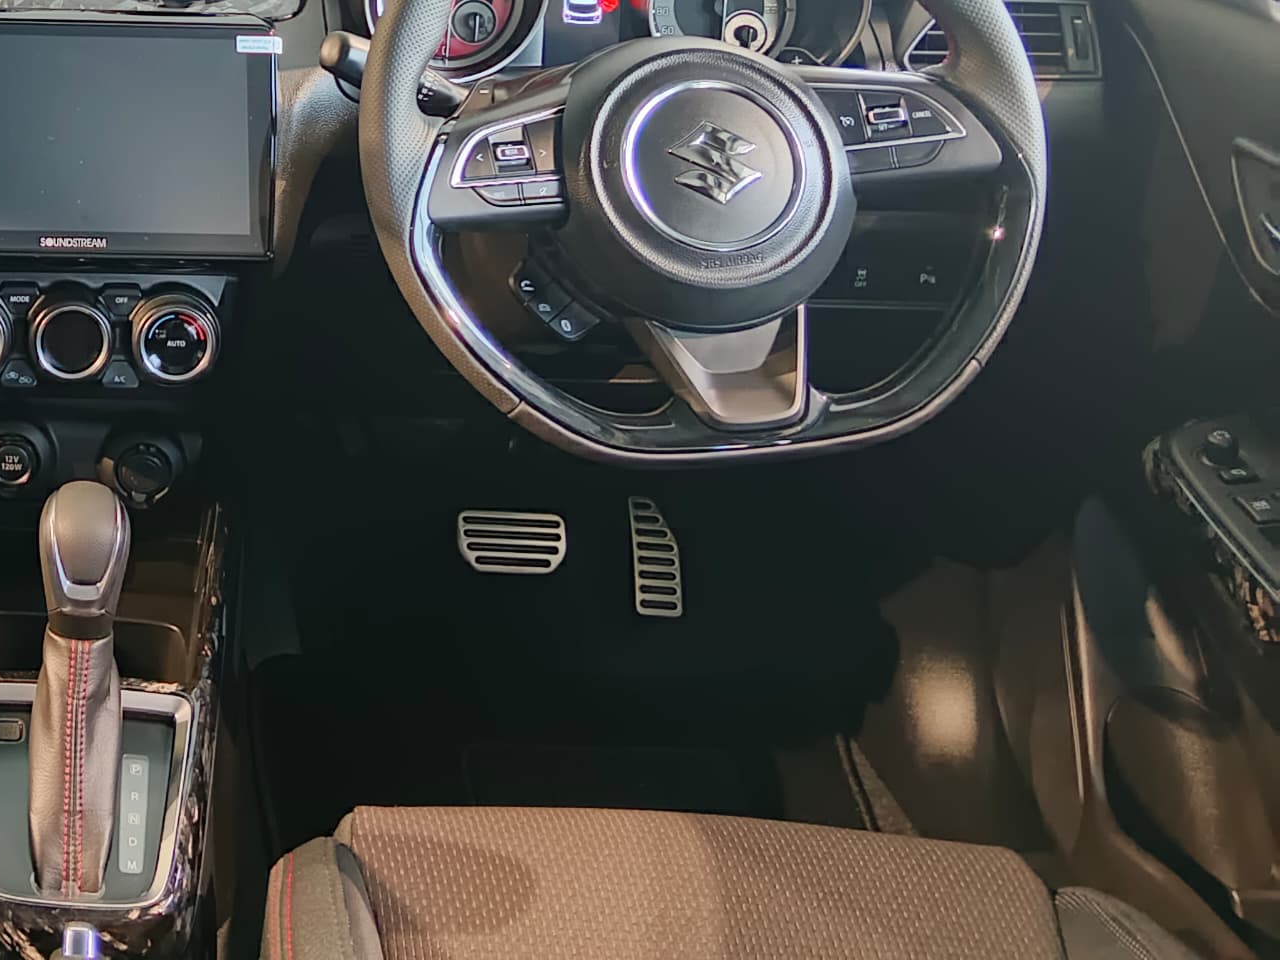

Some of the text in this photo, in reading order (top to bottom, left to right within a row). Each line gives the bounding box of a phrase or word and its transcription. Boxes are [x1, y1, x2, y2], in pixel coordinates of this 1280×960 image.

[656, 7, 669, 16] 80
[661, 25, 674, 35] 60
[39, 237, 107, 248] SOUNDSTREAM
[724, 253, 764, 267] AIRBAG
[10, 295, 30, 303] MODE
[115, 296, 128, 304] OFF
[166, 339, 187, 348] AUTO
[5, 455, 20, 463] 12V
[1, 462, 23, 471] 120W
[130, 791, 139, 801] R
[128, 836, 138, 847] D
[127, 860, 137, 870] M
